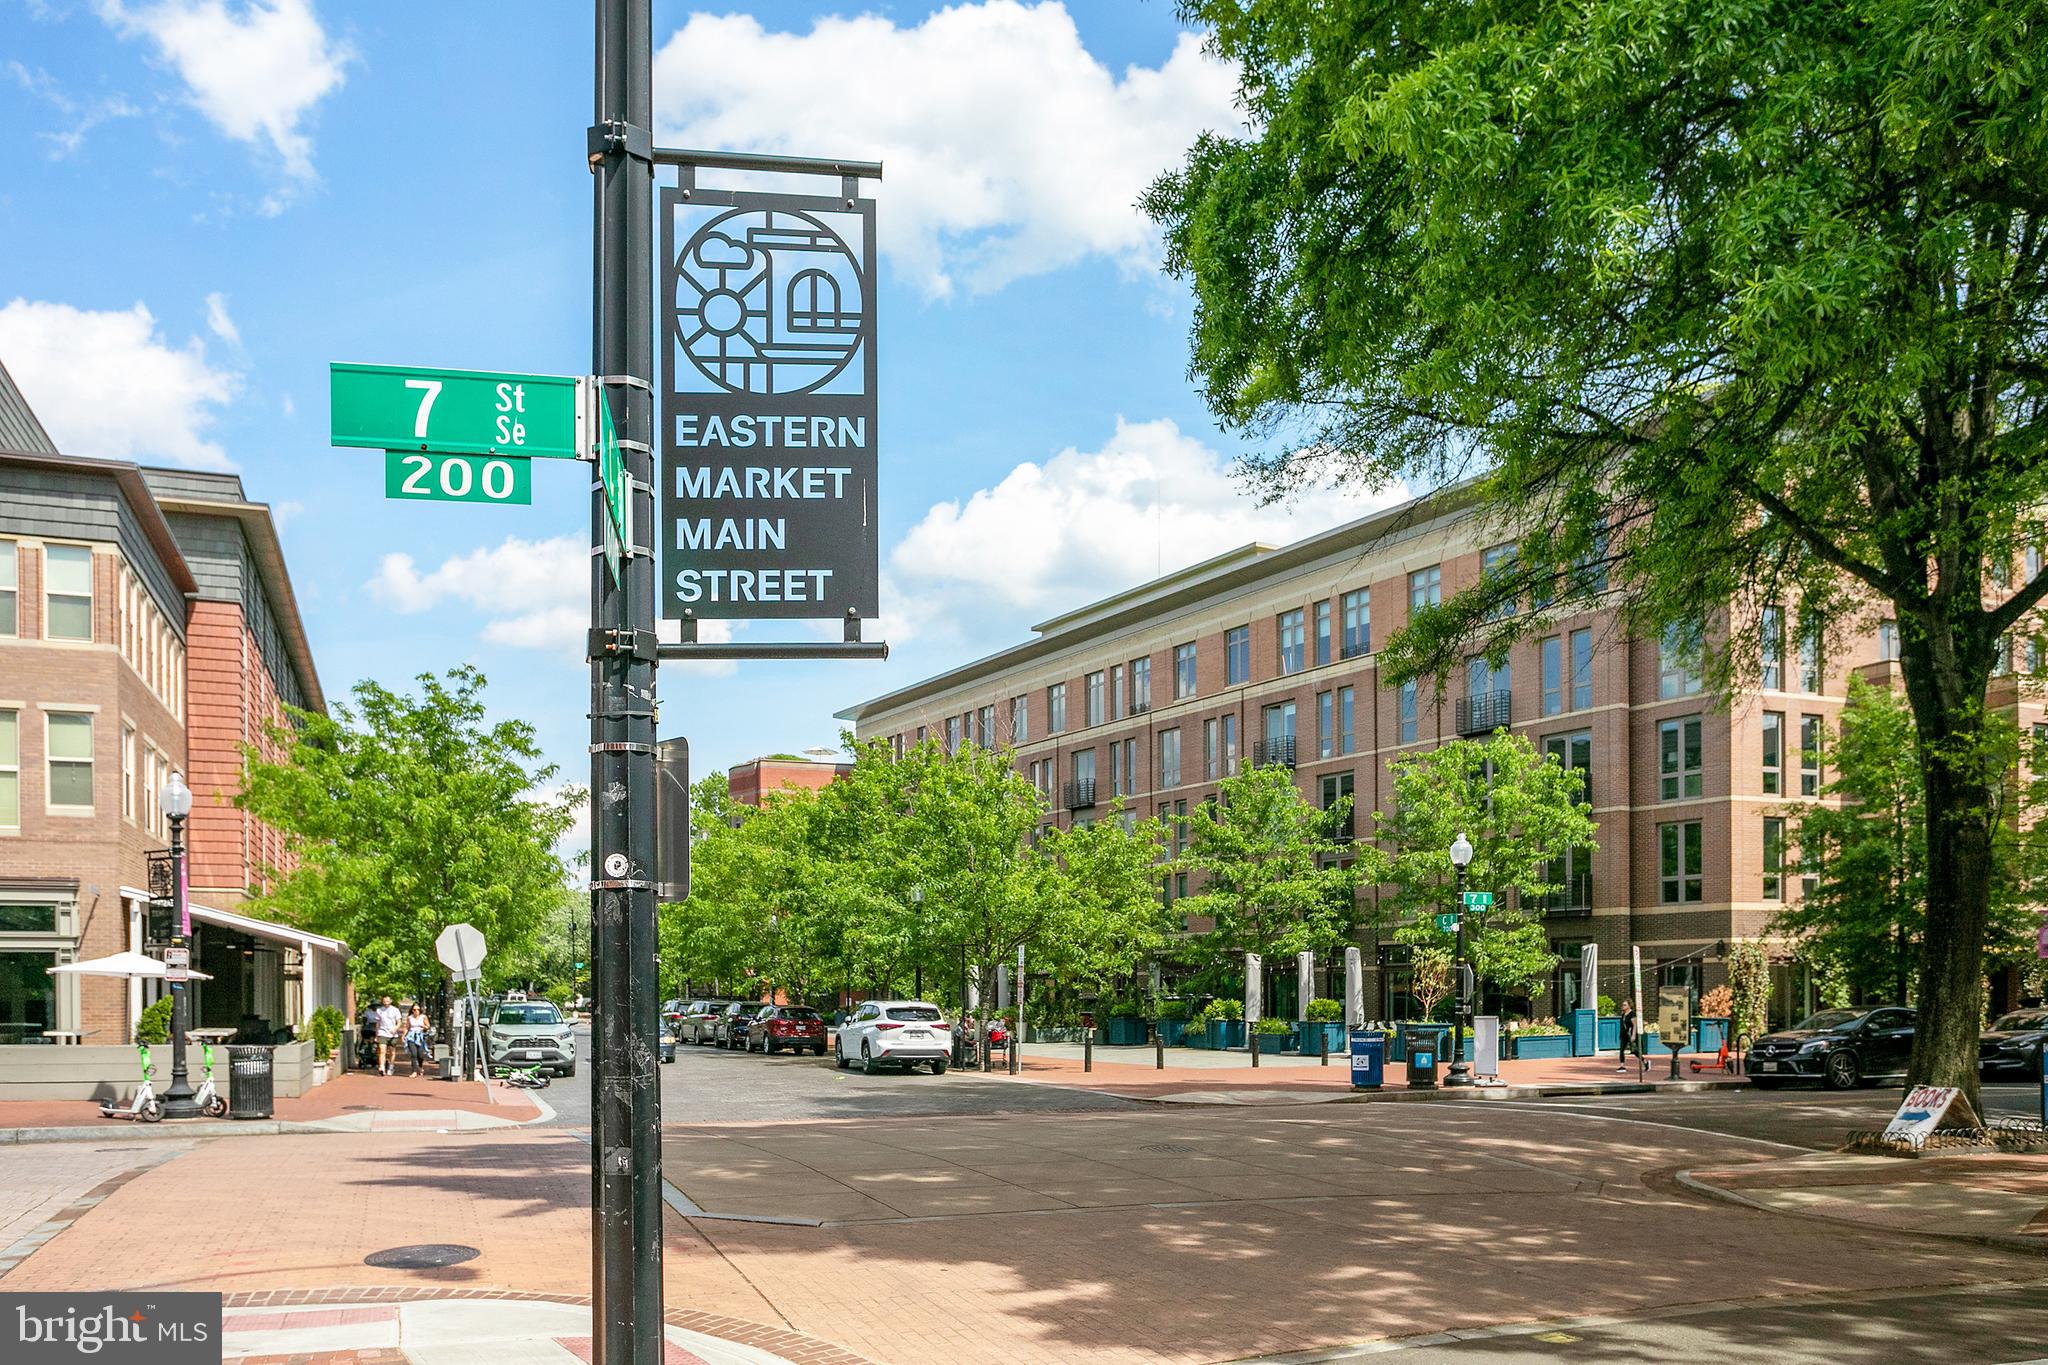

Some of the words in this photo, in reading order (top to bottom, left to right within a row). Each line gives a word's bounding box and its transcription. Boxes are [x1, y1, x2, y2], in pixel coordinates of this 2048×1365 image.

[404, 379, 443, 438] 7
[495, 382, 526, 413] St
[675, 414, 866, 448] EASTERN
[401, 455, 515, 499] 200
[675, 466, 852, 499] MARKET
[676, 518, 786, 550] MAIN
[676, 569, 833, 602] STREET
[1469, 894, 1477, 903] 7
[1904, 1088, 1951, 1108] BOOKS
